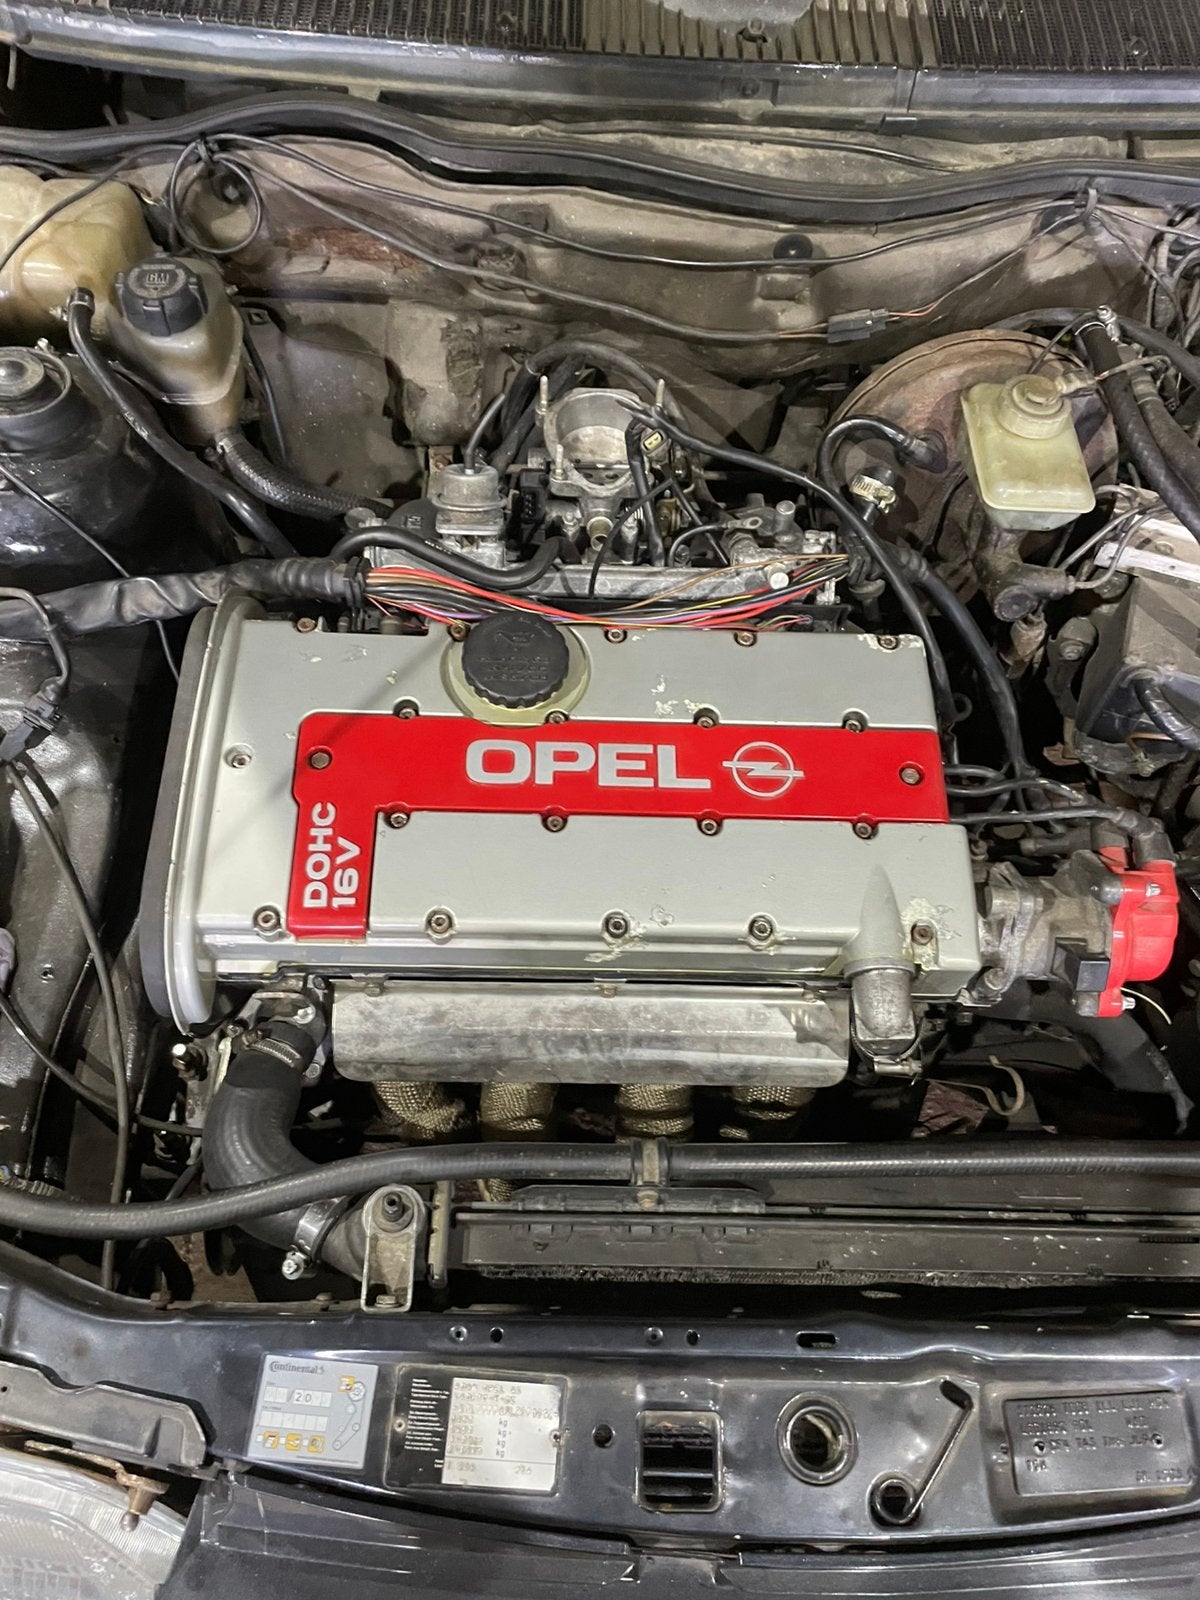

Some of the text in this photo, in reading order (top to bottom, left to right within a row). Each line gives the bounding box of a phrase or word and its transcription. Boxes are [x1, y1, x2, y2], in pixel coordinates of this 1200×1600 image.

[145, 272, 169, 287] GM
[465, 739, 711, 789] OPEL
[303, 802, 336, 908] DOHC
[332, 836, 361, 908] 16V
[269, 1361, 318, 1374] Continental
